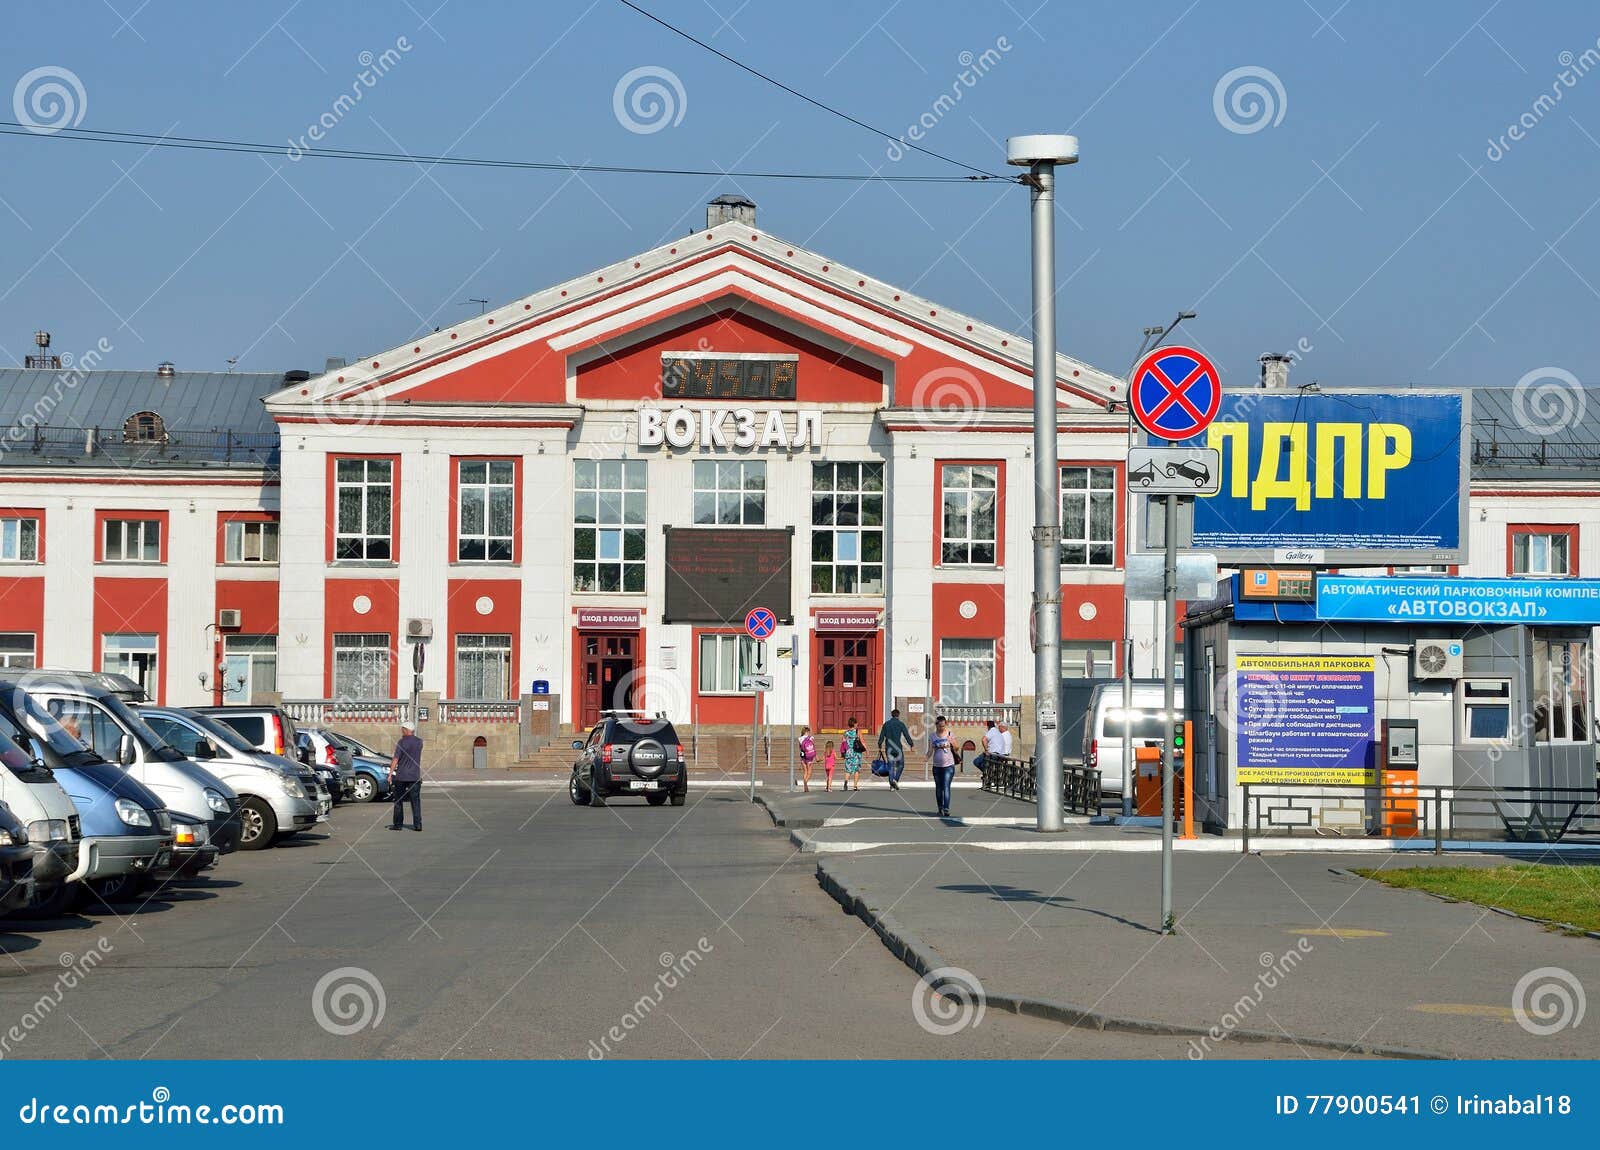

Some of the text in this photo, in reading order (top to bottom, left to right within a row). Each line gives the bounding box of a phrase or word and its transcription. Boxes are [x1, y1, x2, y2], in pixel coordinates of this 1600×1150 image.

[638, 407, 822, 449] ВОКЗАЛ
[1196, 421, 1412, 511] ЛДПР
[1285, 551, 1314, 562] Gallery
[1321, 583, 1600, 599] АВТОМАТИЧЕСКИЙ ПАРКОВОЧНЫЙ КОМПЛЕ
[1387, 599, 1548, 617] «АВТОВОКЗАЛ»
[1240, 660, 1321, 668] АВТОМОБИЛЬНАЯ
